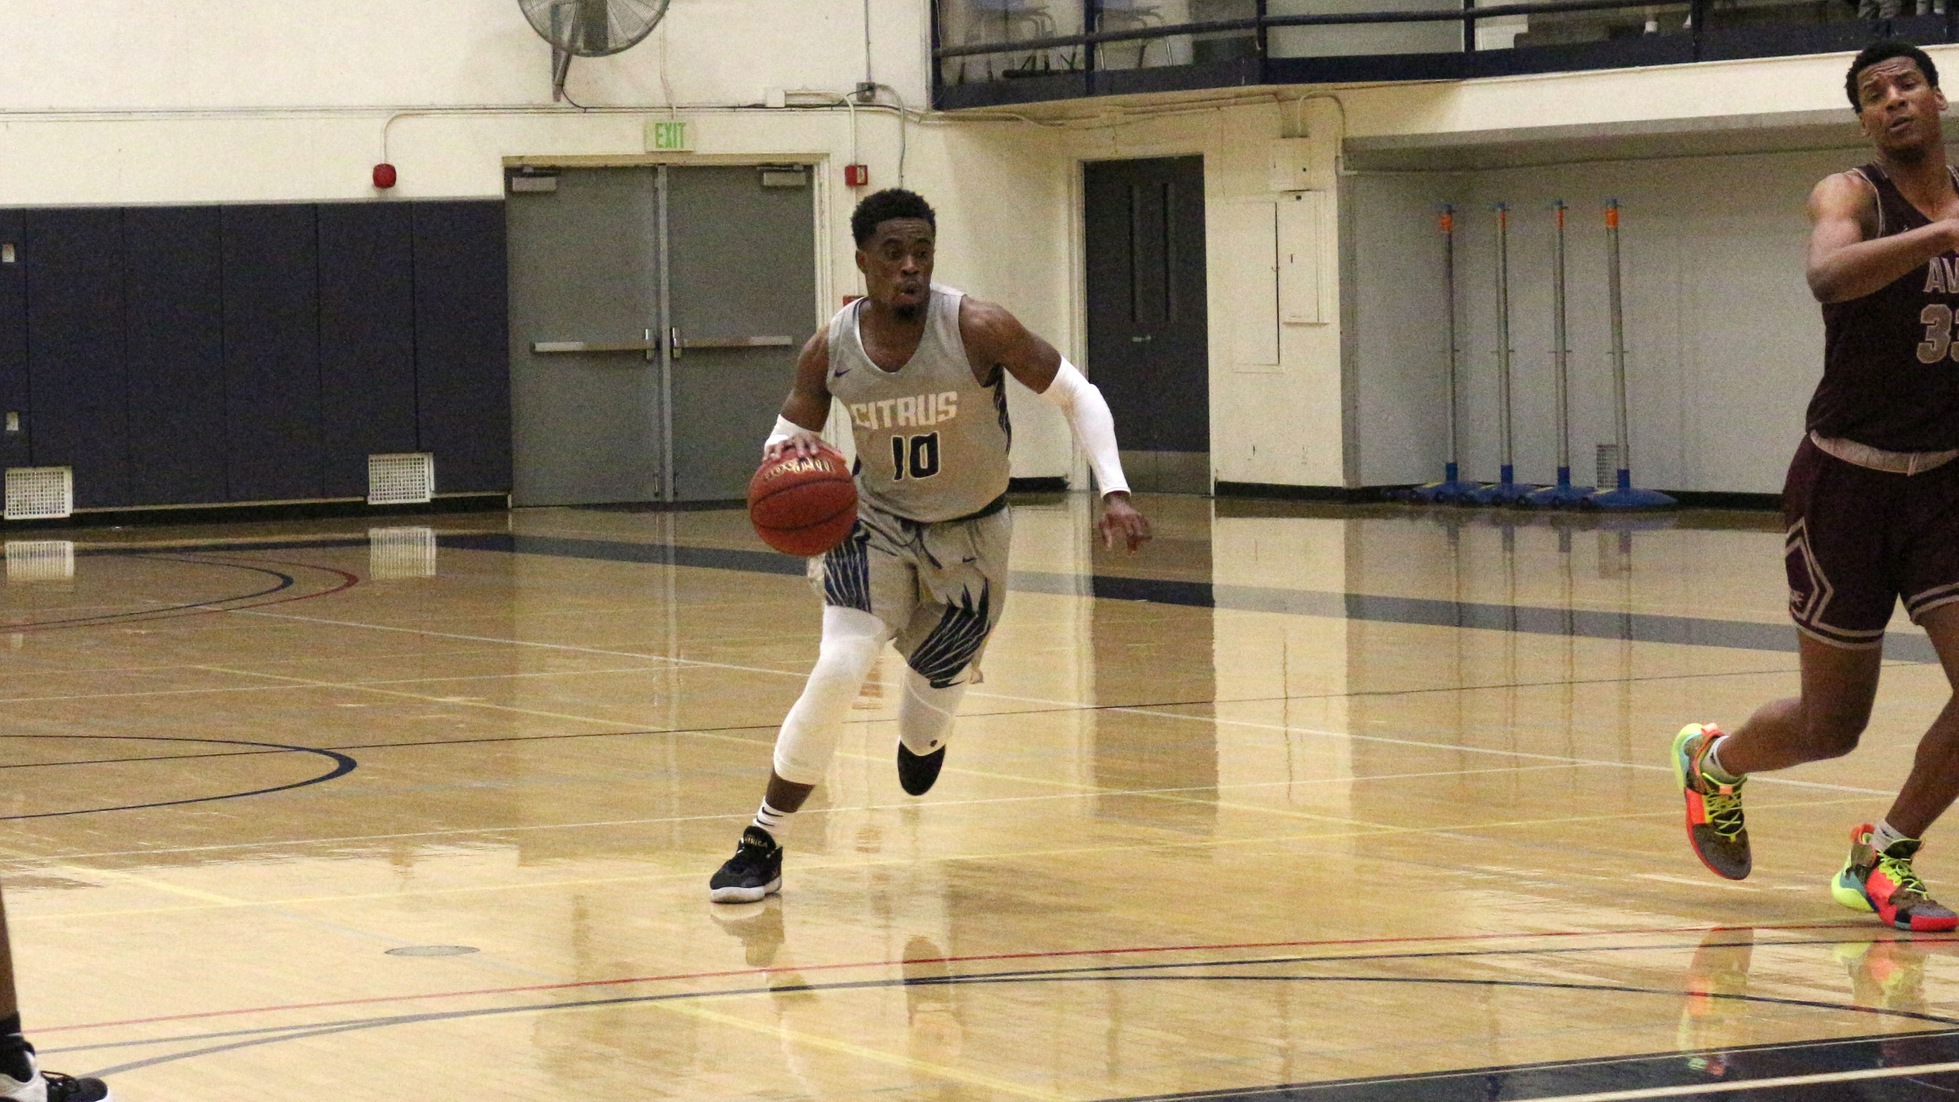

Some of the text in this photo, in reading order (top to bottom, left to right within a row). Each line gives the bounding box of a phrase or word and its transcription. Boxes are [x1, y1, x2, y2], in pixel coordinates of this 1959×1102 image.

[655, 122, 686, 148] EXIT
[1922, 256, 1959, 293] AV
[850, 391, 958, 430] CITRUS
[891, 430, 940, 482] 10
